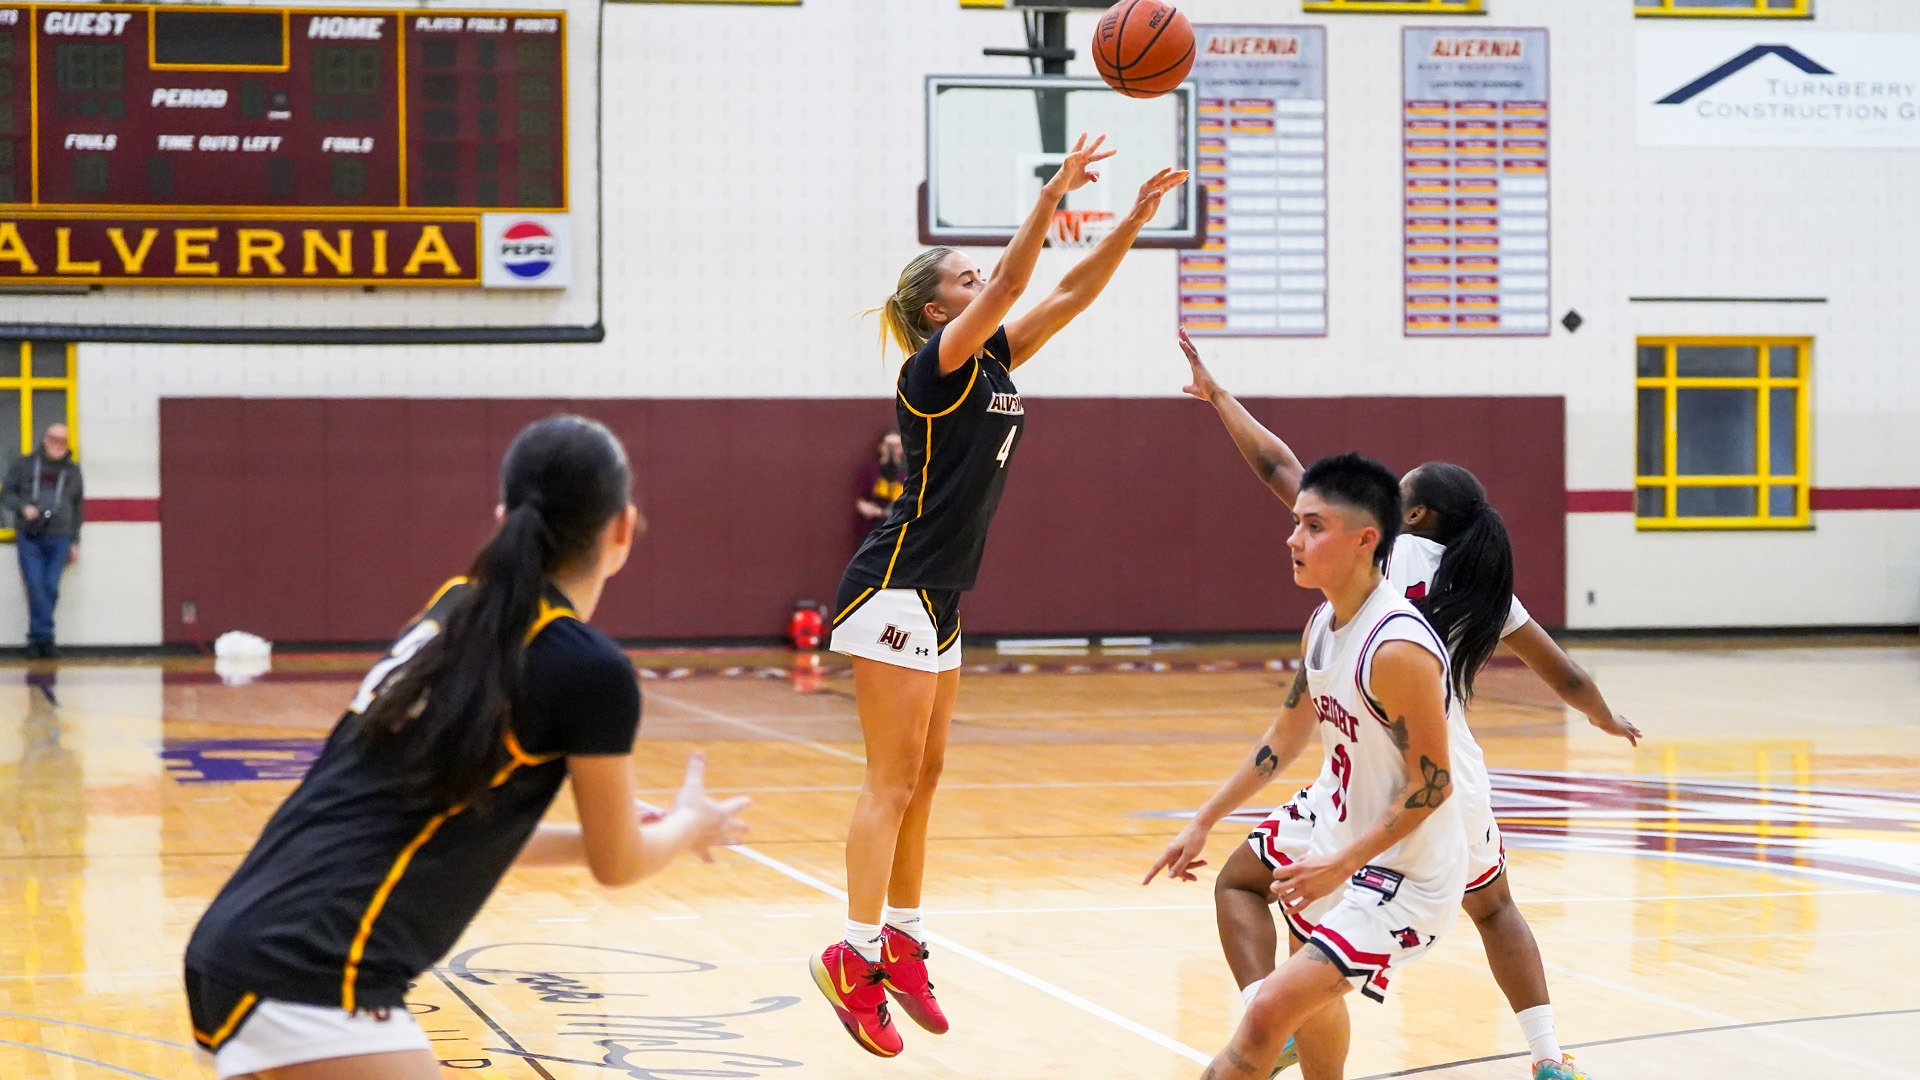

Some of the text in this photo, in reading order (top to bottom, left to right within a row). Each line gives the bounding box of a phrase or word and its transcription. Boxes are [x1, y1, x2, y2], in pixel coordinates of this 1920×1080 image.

[44, 12, 131, 36] GUEST
[308, 16, 385, 40] HOME
[415, 17, 464, 32] PLAYER
[466, 17, 508, 33] FOULS
[1207, 36, 1297, 55] ALVERNIA
[1432, 38, 1521, 57] ALVERNIA
[1767, 78, 1916, 97] TURNBERRY
[151, 88, 228, 109] PERIOD
[1697, 101, 1889, 119] CONSTRUCTION
[64, 133, 118, 151] FOULS
[157, 134, 282, 152] TIME OUTS LEFT
[322, 136, 374, 153] FOULS
[0, 222, 461, 275] ALVERNIA
[501, 243, 554, 256] PEPSI
[995, 425, 1018, 468] 4
[878, 624, 910, 651] AU
